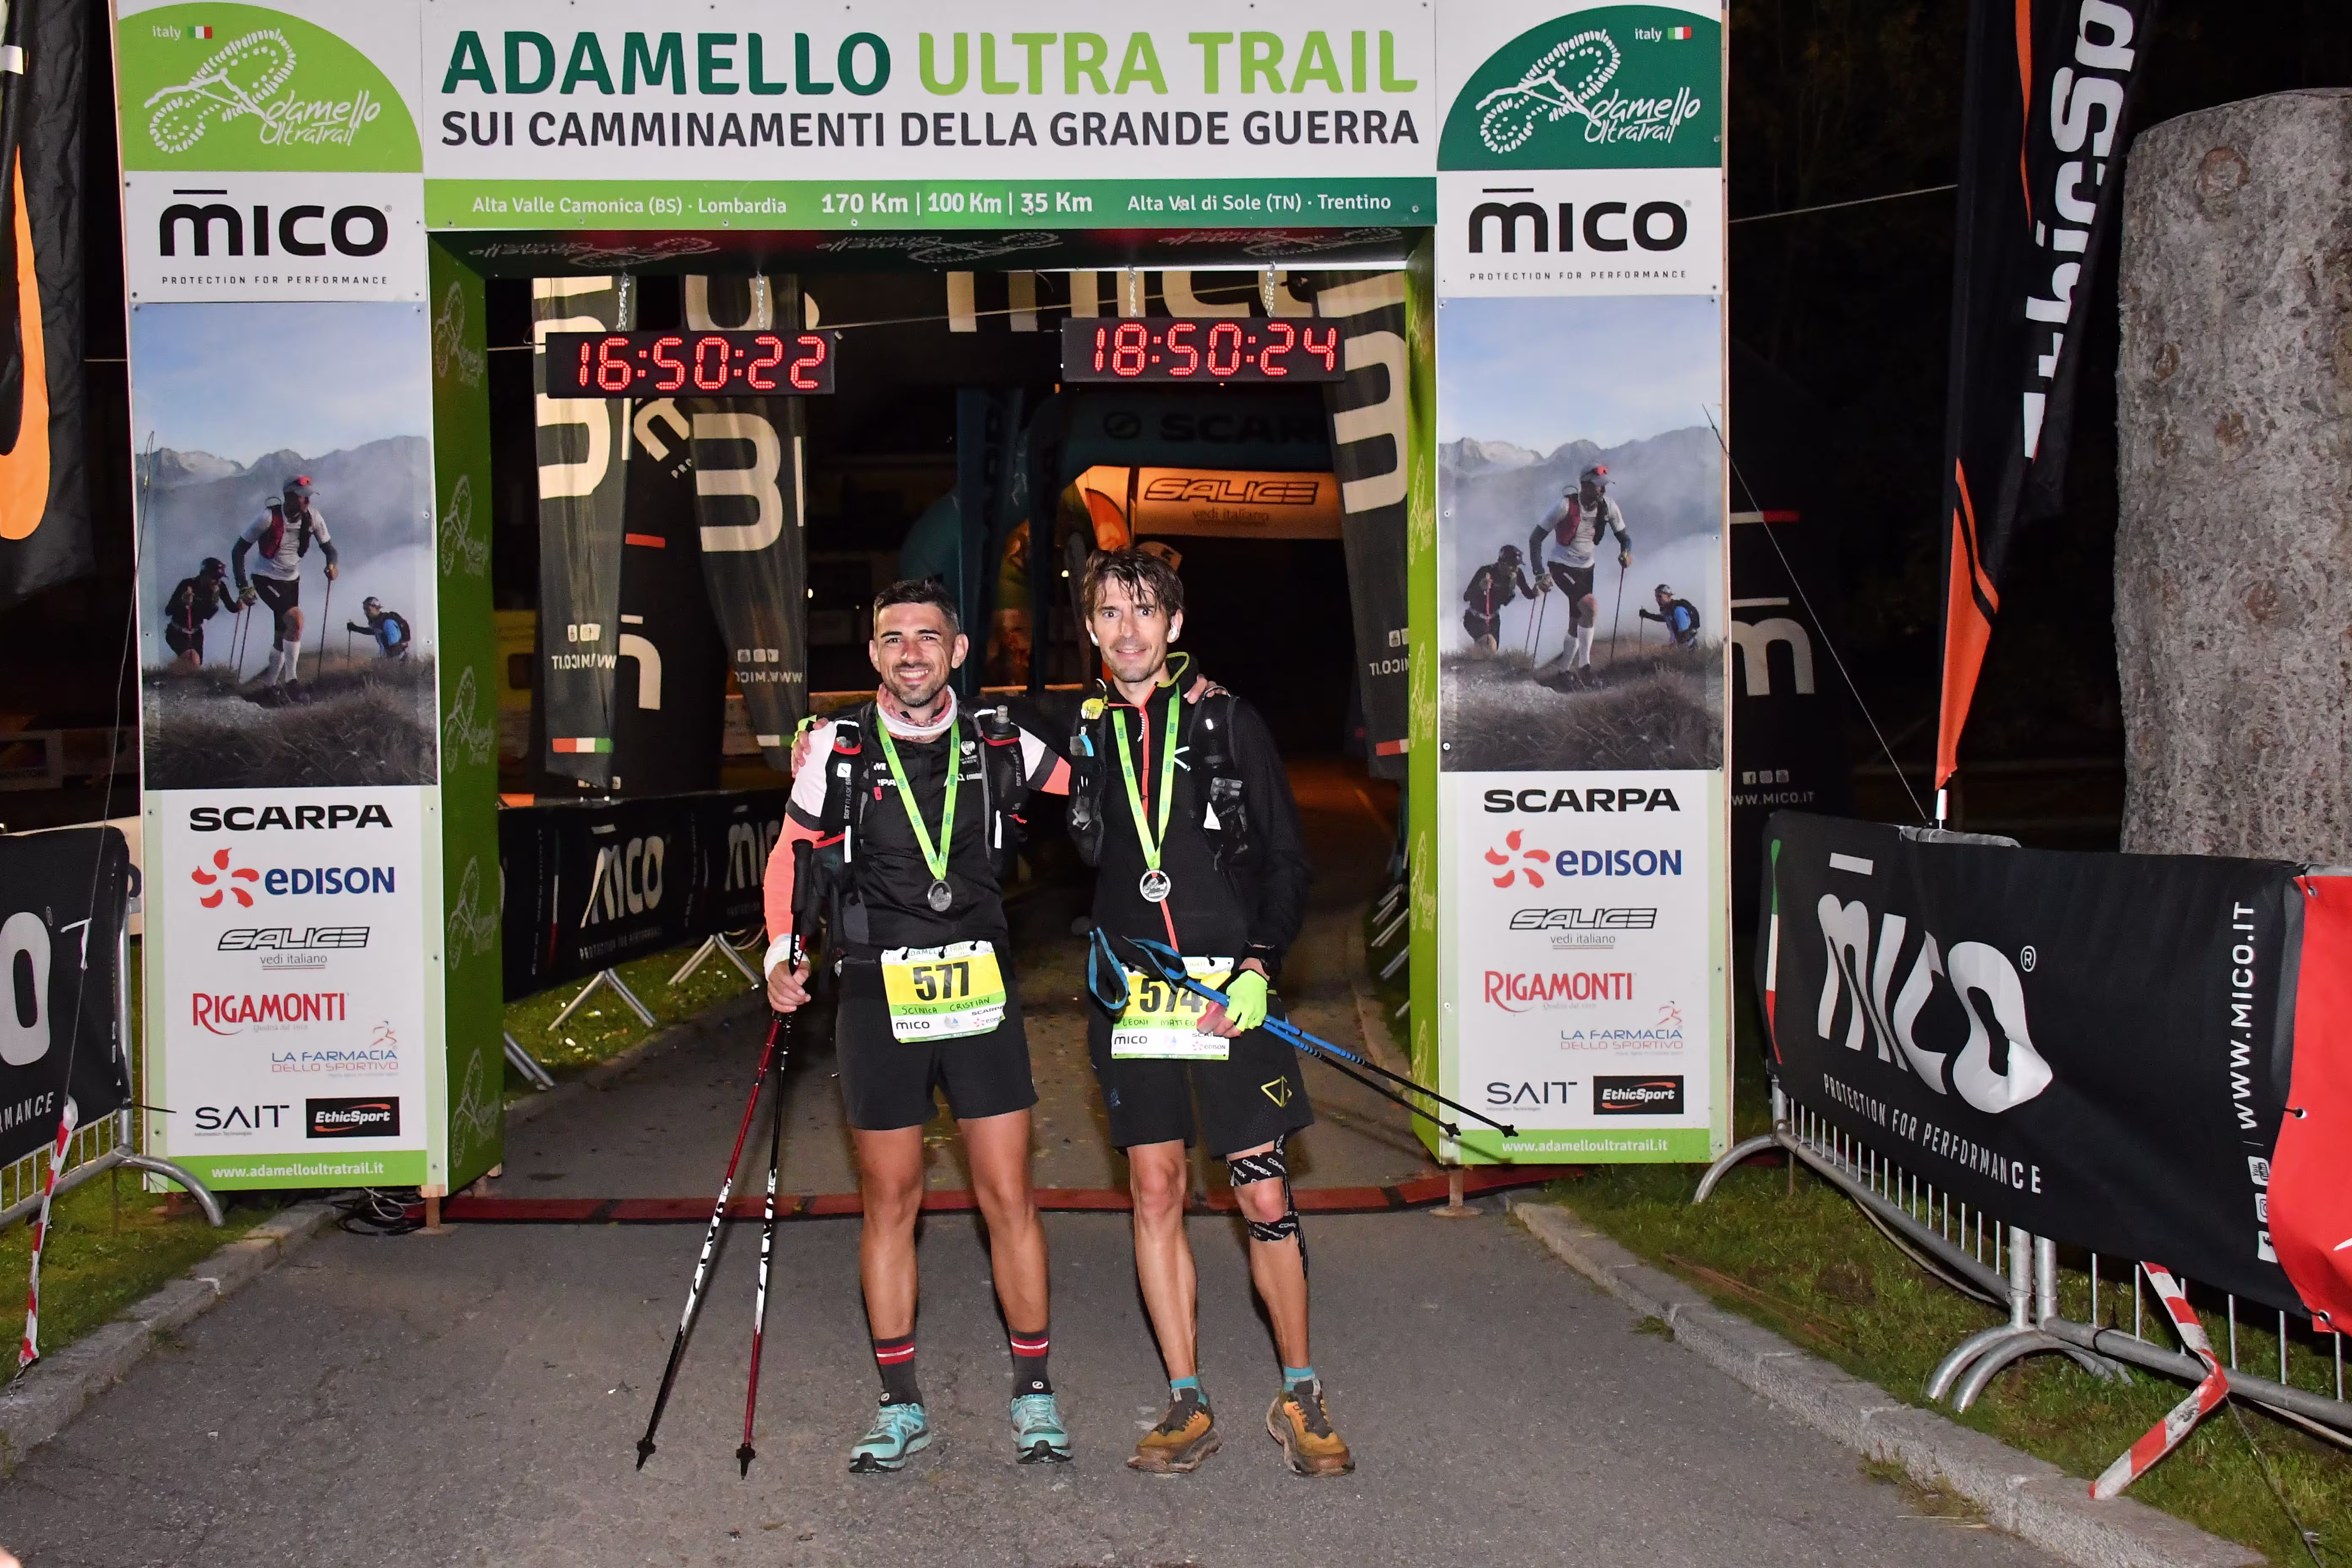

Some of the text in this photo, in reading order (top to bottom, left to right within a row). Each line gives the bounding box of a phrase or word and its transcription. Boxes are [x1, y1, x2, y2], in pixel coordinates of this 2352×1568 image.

[152, 25, 182, 41] italy
[1634, 27, 1662, 42] italy
[441, 30, 1418, 96] ADAMELLO ULTRA TRAIL
[441, 109, 1419, 147] SUI CAMMINAMENTI DELLA GRANDE GUERRA
[473, 196, 786, 216] Alta Valle Camonica (BS) Lombardia
[822, 193, 908, 214] 170 Km
[928, 193, 1002, 213] 100 Km
[1021, 193, 1092, 213] 35 Km
[1128, 194, 1391, 214] Alta Val di Sole (TN) Trentino
[162, 276, 387, 285] PROTECTION FOR PERFORMANCE
[1470, 271, 1686, 280] PROTECTION FOR PERFORMANCE
[1094, 323, 1337, 376] 18:50:24
[579, 336, 826, 390] 16:50:22
[1144, 478, 1319, 505] SALICE
[1484, 788, 1680, 813] SCARPA
[190, 805, 393, 831] SCARPA
[1509, 908, 1657, 929] SALICE
[218, 927, 370, 950] SALICE
[1550, 934, 1616, 944] vedi italiano
[260, 953, 327, 964] vedi italiano
[913, 961, 969, 1001] 577
[1485, 971, 1632, 1013] RIGAMONTI
[193, 993, 345, 1036] RIGAMONTI
[950, 997, 990, 1012] CRISTIAN
[2230, 901, 2257, 1130] WWW.MICO.IT
[1561, 1029, 1682, 1040] LA FARMACIA
[1561, 1041, 1683, 1049] DELLO SPORTIVO
[272, 1050, 397, 1062] LA FARMACIA
[272, 1062, 398, 1073] DELLO SPORTIVO
[1486, 1082, 1577, 1104] SAIT
[1602, 1088, 1675, 1102] EthicSport
[195, 1105, 290, 1130] SAIT
[315, 1110, 391, 1124] EthicSport
[1824, 1073, 2041, 1194] PROTECTION FOR PERFORMANCE
[1503, 1139, 1667, 1152] www.adamelloultratrail.it
[212, 1162, 384, 1178] www.adamelloultratrail.it
[1242, 1159, 1271, 1176] COMPEX
